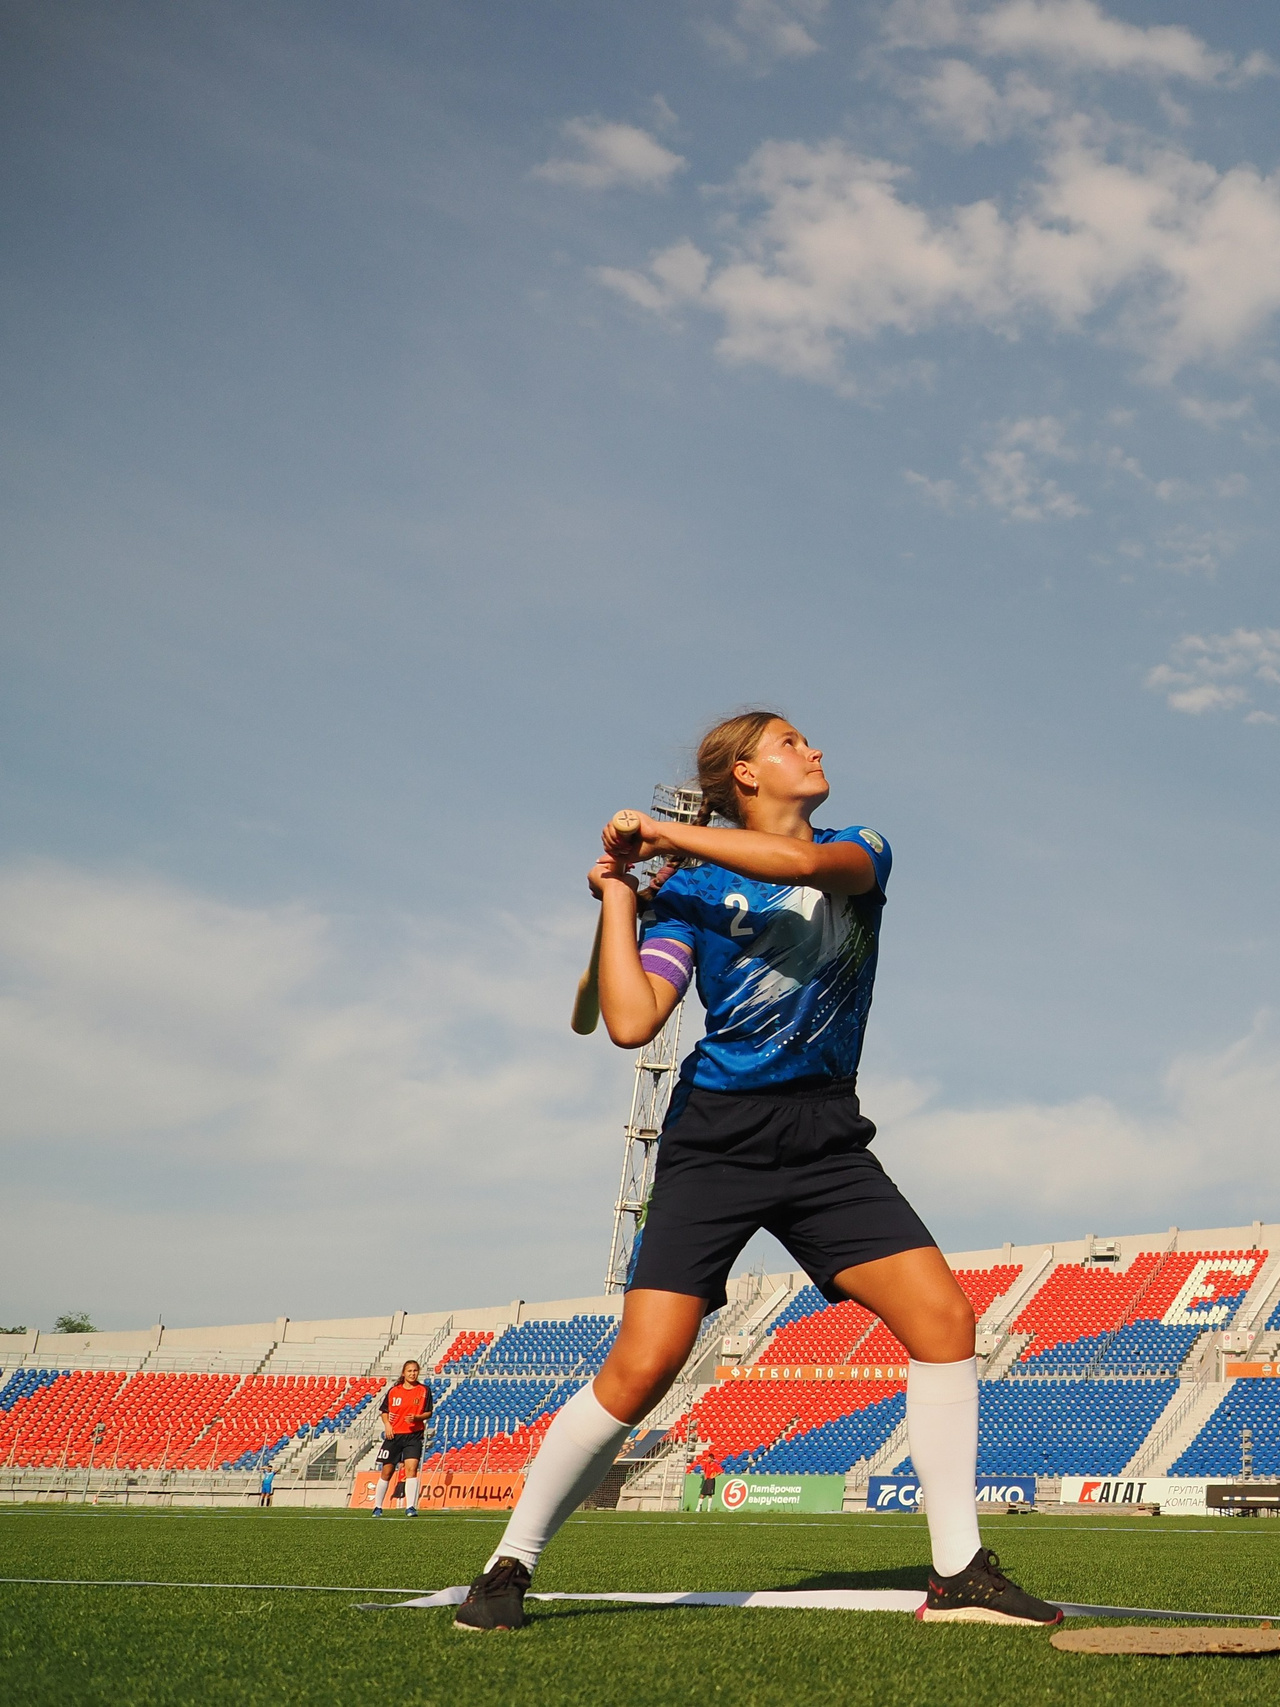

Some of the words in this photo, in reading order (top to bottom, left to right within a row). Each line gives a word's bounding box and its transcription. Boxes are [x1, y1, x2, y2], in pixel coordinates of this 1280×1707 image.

[724, 893, 753, 937] 2
[730, 1367, 801, 1379] ФУТБОЛ
[815, 1367, 908, 1379] ПО-НОВОМ
[391, 1397, 402, 1407] 10
[378, 1449, 390, 1460] 10
[419, 1485, 445, 1500] ДО
[449, 1485, 514, 1502] ПИЦЦА
[728, 1481, 744, 1503] 5
[750, 1484, 802, 1495] Пятёрочка
[1098, 1482, 1147, 1503] АГАТ
[1168, 1485, 1204, 1495] ГРУППА
[748, 1495, 800, 1506] выручает!
[1165, 1498, 1206, 1507] КОМПАН
